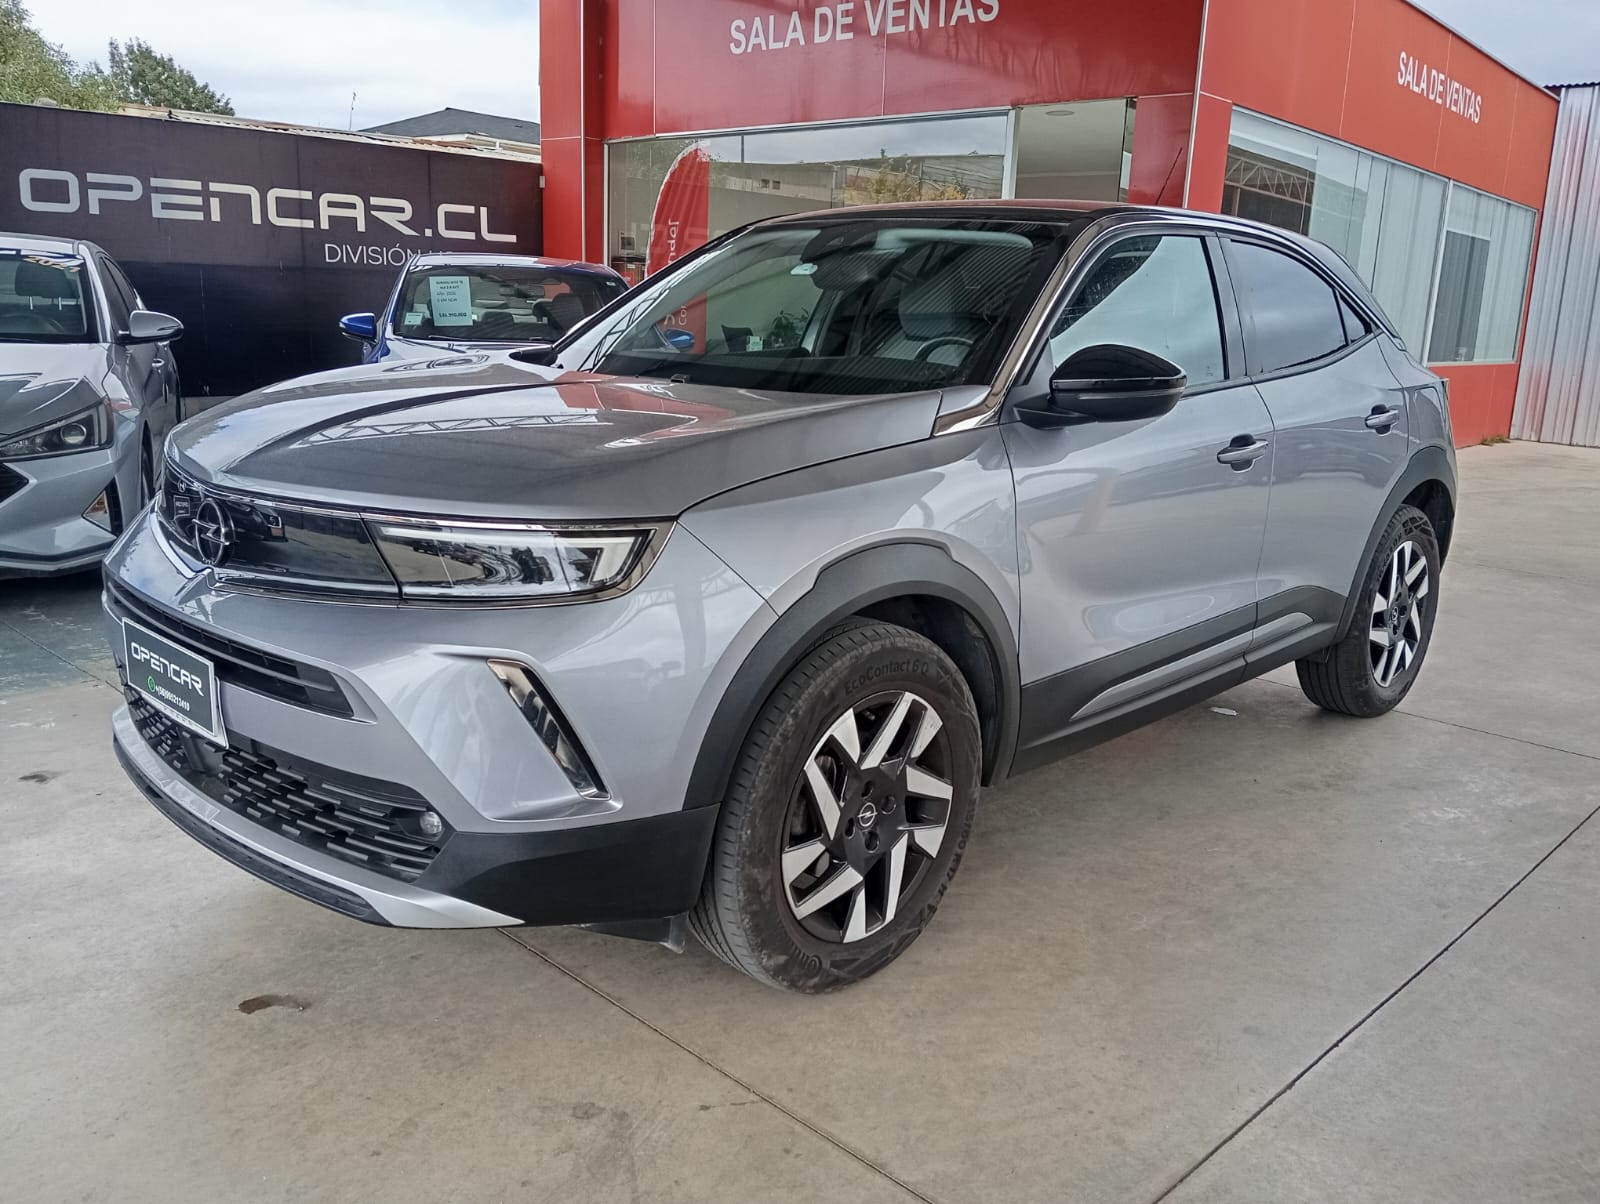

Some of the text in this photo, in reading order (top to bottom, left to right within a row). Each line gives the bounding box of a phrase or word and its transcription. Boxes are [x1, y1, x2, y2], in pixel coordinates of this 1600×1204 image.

[729, 11, 806, 55] SALA
[814, 3, 854, 43] DE
[1397, 51, 1482, 124] SALA DE VENTAS
[18, 167, 518, 243] OPENCAR.CL
[130, 641, 205, 697] OPENCAR
